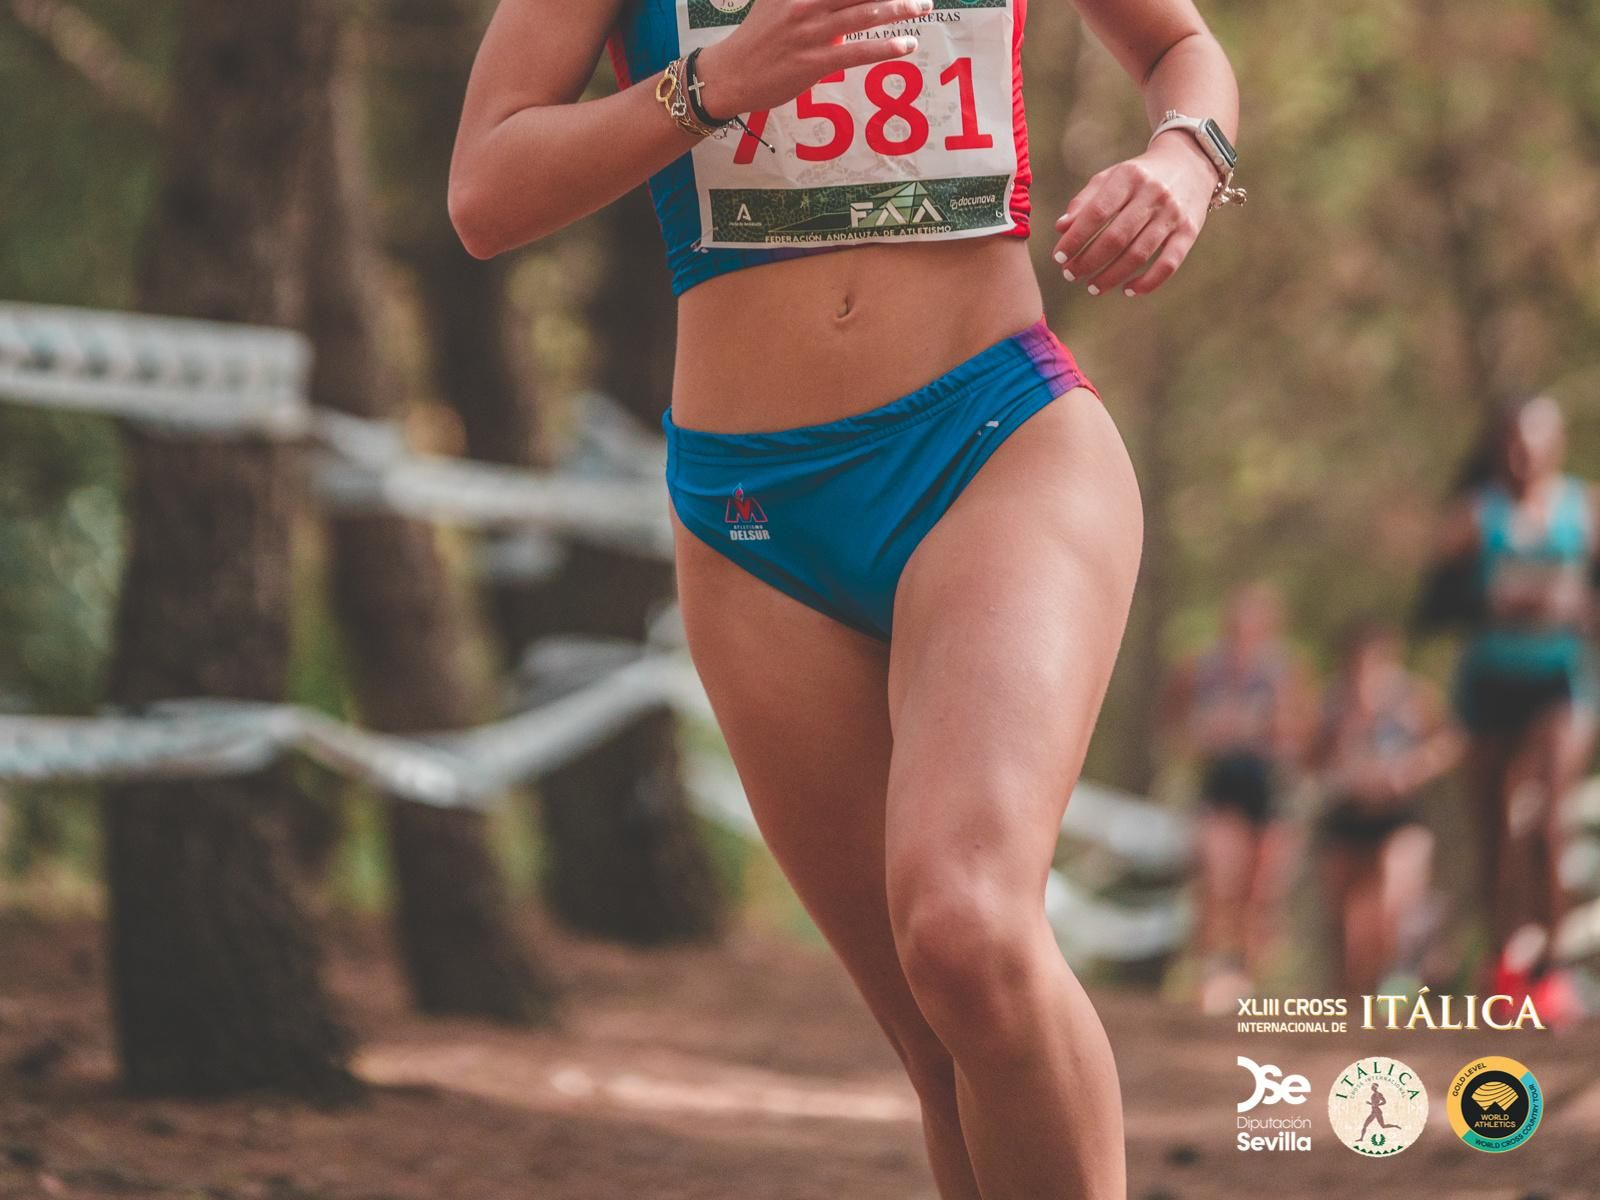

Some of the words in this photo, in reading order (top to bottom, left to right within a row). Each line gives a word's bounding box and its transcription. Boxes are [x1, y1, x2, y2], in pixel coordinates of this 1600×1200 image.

[866, 31, 880, 40] LA
[958, 194, 996, 206] docunova
[765, 232, 822, 243] FEDERACIÓN
[826, 231, 879, 242] ANDALUZA
[883, 229, 896, 238] DE
[900, 225, 952, 237] ATLETISMO
[730, 530, 771, 541] DELSUR
